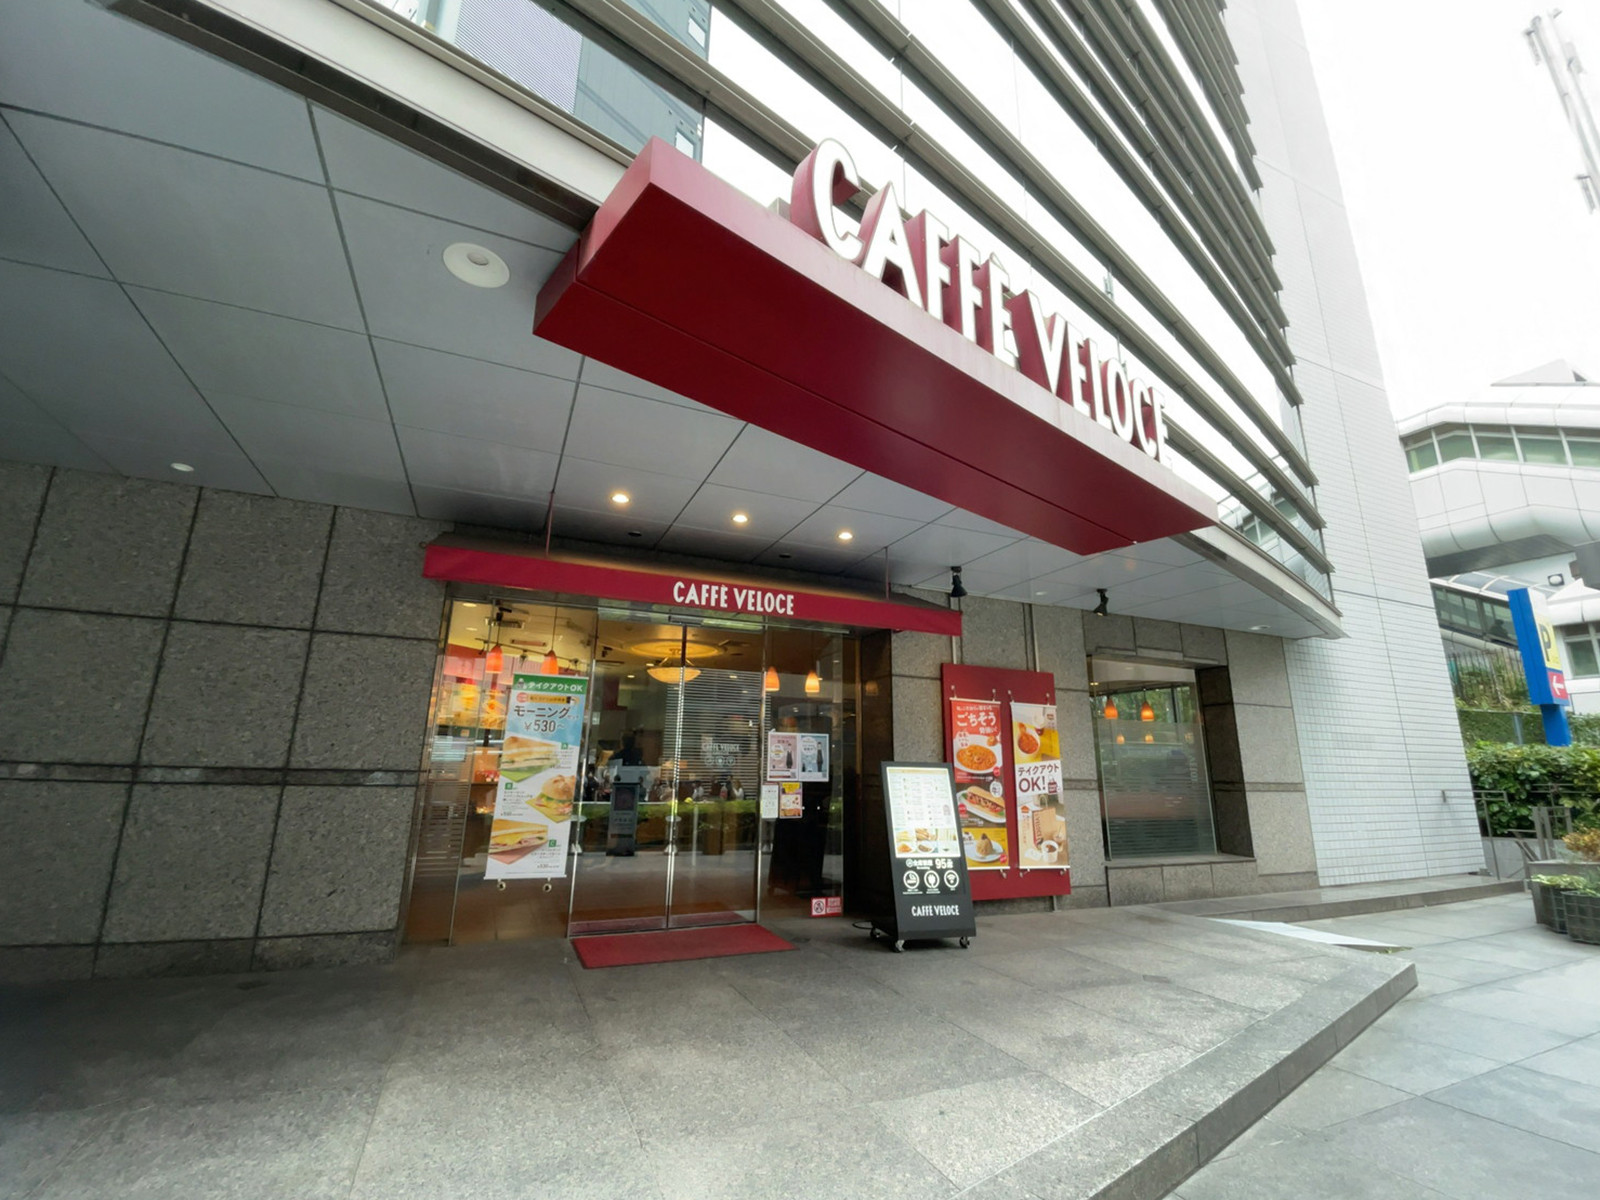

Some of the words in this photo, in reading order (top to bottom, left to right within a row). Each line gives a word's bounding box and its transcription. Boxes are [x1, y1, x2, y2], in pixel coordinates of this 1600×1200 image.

[1025, 288, 1172, 469] VELOCE
[733, 588, 794, 615] VELOCE
[1540, 624, 1551, 662] P
[956, 711, 997, 727] ごちそう
[1018, 764, 1060, 776] テイクアウト
[1018, 776, 1046, 793] OK!
[934, 904, 960, 916] VELOCE
